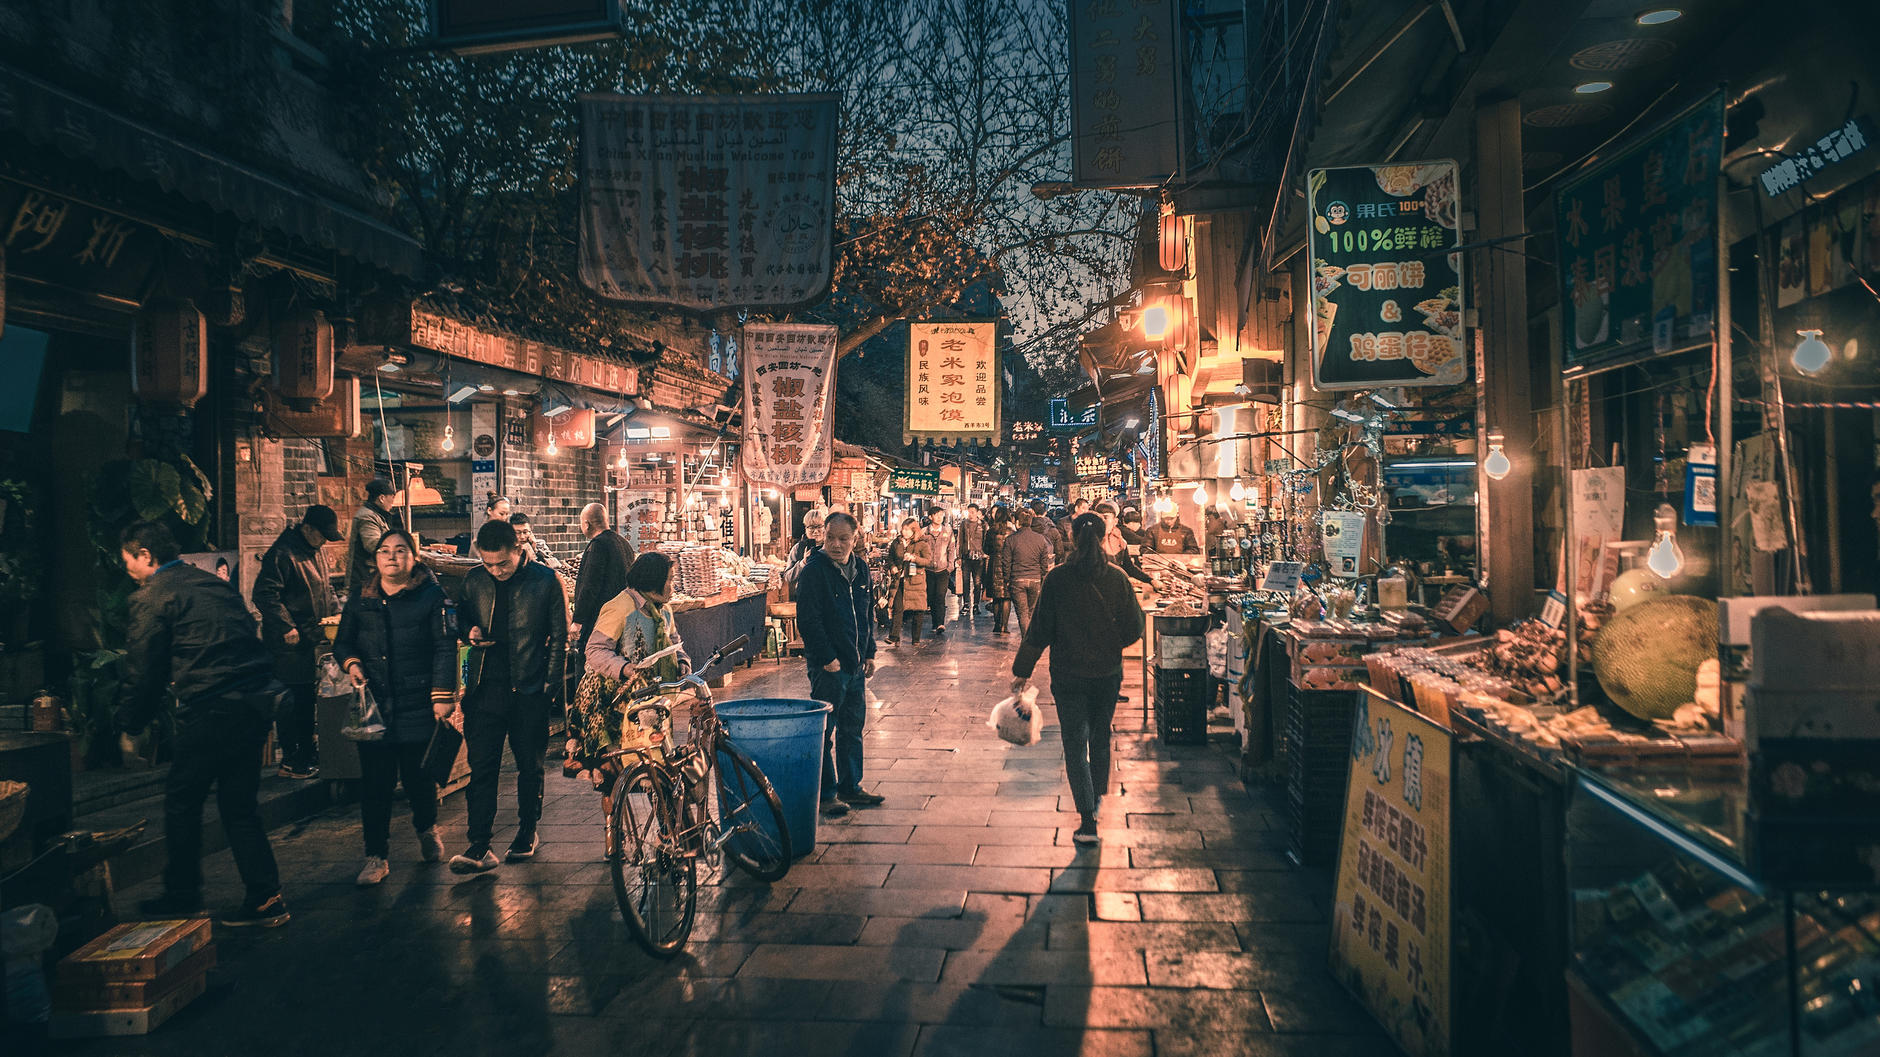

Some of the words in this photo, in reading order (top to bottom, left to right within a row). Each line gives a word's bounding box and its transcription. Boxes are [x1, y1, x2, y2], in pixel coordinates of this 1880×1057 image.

[1134, 0, 1160, 77] 大舅
[731, 148, 785, 161] Welcome
[792, 148, 815, 161] You
[677, 166, 730, 279] 椒盐核桃
[1346, 260, 1425, 291] 可丽饼
[1380, 299, 1402, 323] &
[1349, 330, 1430, 361] 鸡蛋仔
[918, 360, 930, 405] 民族风味
[939, 338, 967, 421] 老米家泡馍
[976, 360, 987, 406] 欢迎品尝
[535, 429, 584, 442] 香核桃
[770, 376, 805, 465] 椒盐核桃
[1109, 460, 1122, 487] 宾馆
